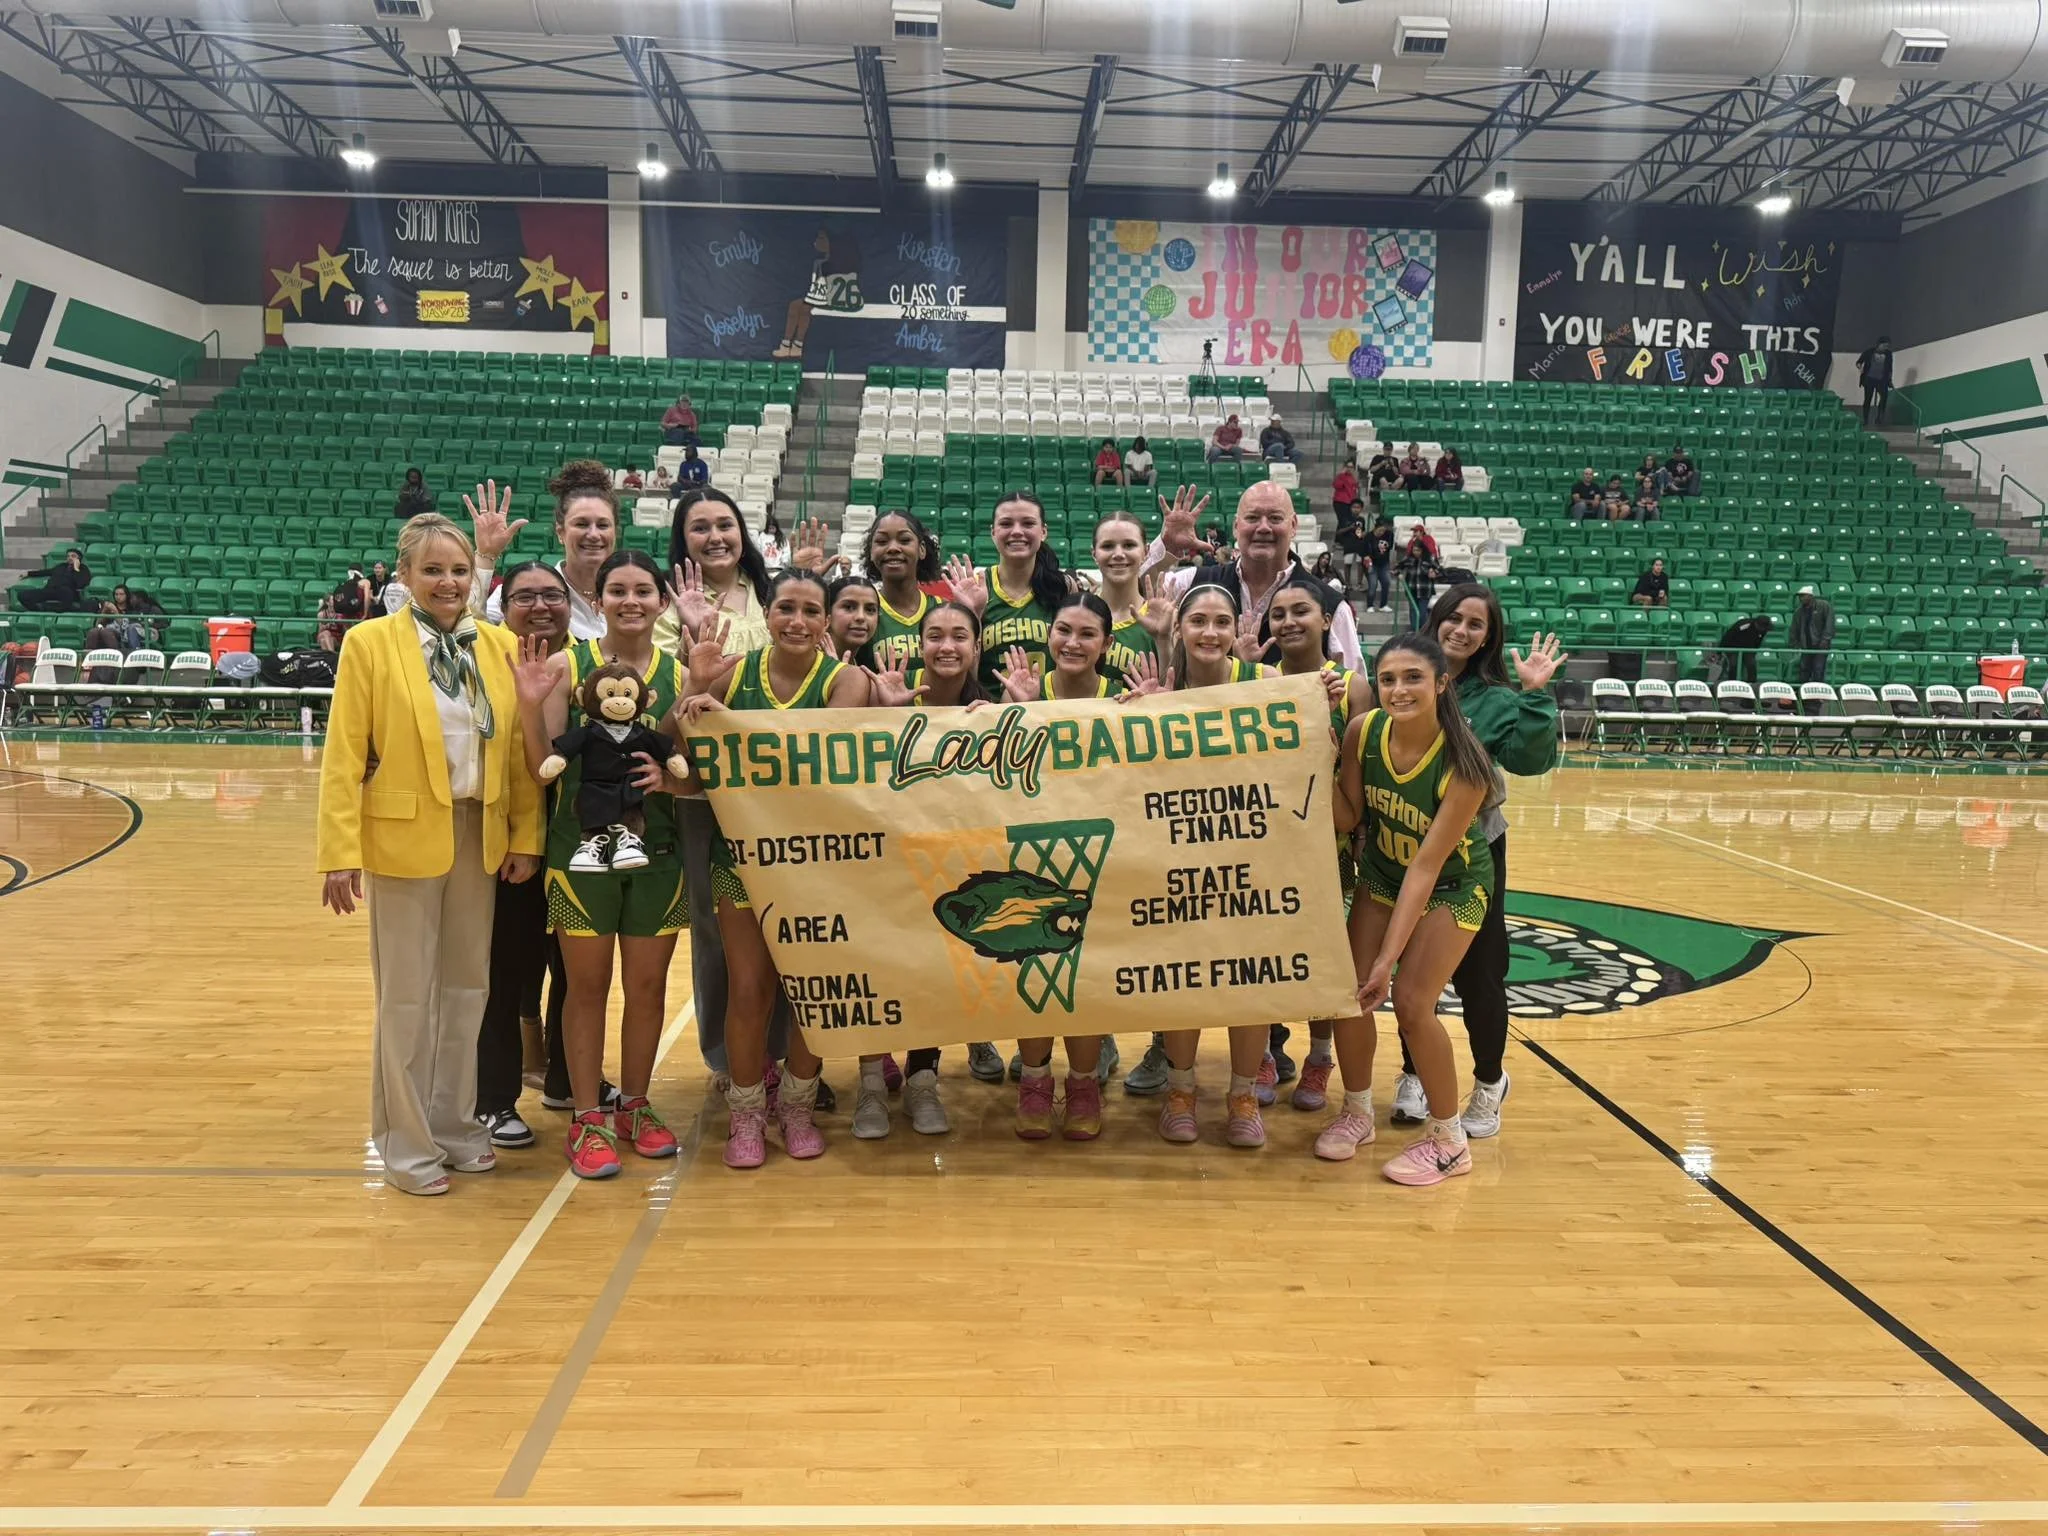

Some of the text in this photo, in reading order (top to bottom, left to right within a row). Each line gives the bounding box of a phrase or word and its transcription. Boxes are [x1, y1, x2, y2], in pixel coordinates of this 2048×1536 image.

[347, 248, 513, 282] The sequel is better
[709, 231, 763, 267] Emily
[896, 232, 962, 277] Kirsten
[1201, 225, 1369, 275] IN OUR
[1569, 234, 1686, 290] Y'ALL
[831, 276, 863, 307] 26
[889, 283, 967, 306] CLASS OF
[1188, 271, 1368, 320] JUNIOR
[704, 304, 771, 346] Joselyn
[901, 305, 970, 322] 20 something
[1224, 318, 1304, 366] ERA
[1540, 312, 1603, 346] YOU
[1631, 316, 1712, 350] WERE
[1741, 324, 1821, 355] THIS
[1528, 343, 1567, 380] Maria
[1586, 346, 1768, 386] FRESH
[873, 634, 923, 668] BISH
[982, 617, 1052, 652] BISHO
[686, 700, 1301, 799] BISHOP Lady BADGERS
[1144, 783, 1280, 820] REGIONAL
[1169, 811, 1268, 845] FINALS
[1166, 863, 1252, 896] STATE
[1130, 886, 1301, 927] SEMIFINALS
[778, 914, 849, 944] AREA
[782, 973, 878, 1002] GIONAL
[1115, 952, 1310, 996] STATE FINALS
[794, 1000, 902, 1030] IFINALS
